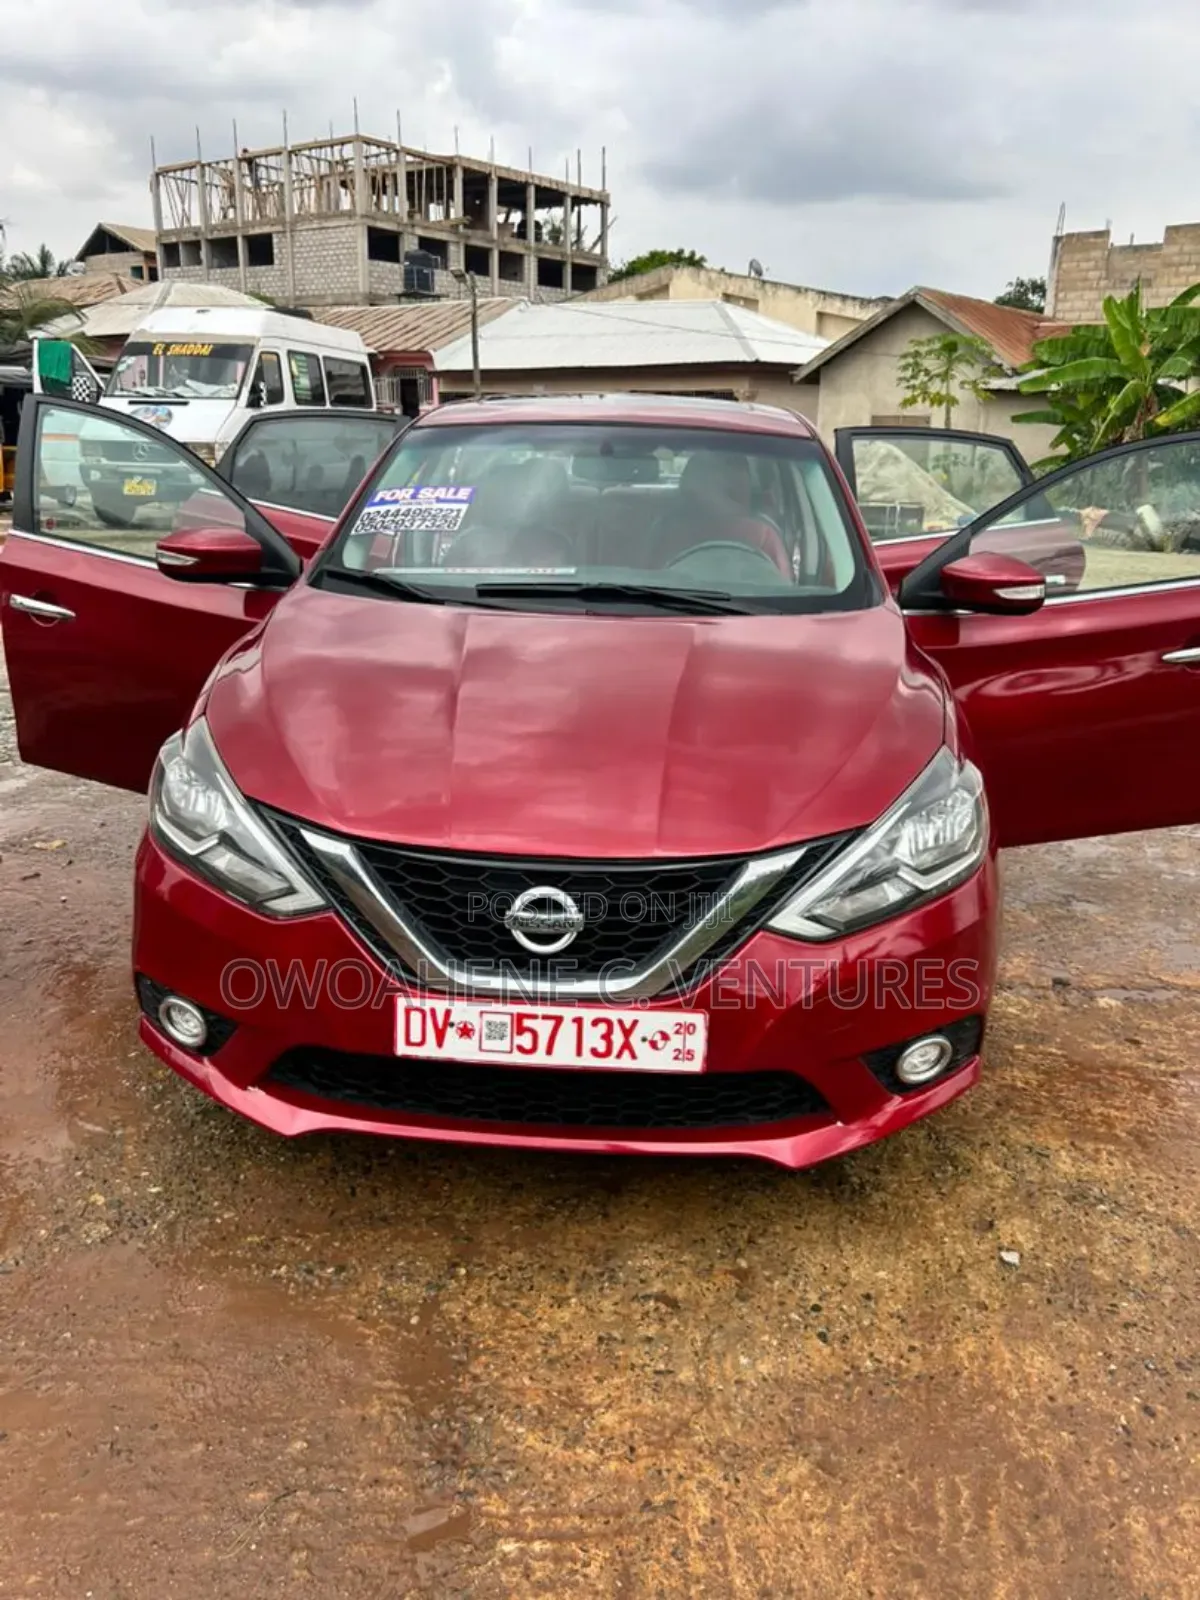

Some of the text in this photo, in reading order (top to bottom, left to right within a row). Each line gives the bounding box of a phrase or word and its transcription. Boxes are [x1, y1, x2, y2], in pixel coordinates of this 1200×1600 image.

[373, 486, 473, 502] FOR SALE
[404, 1007, 640, 1060] DV 5713X
